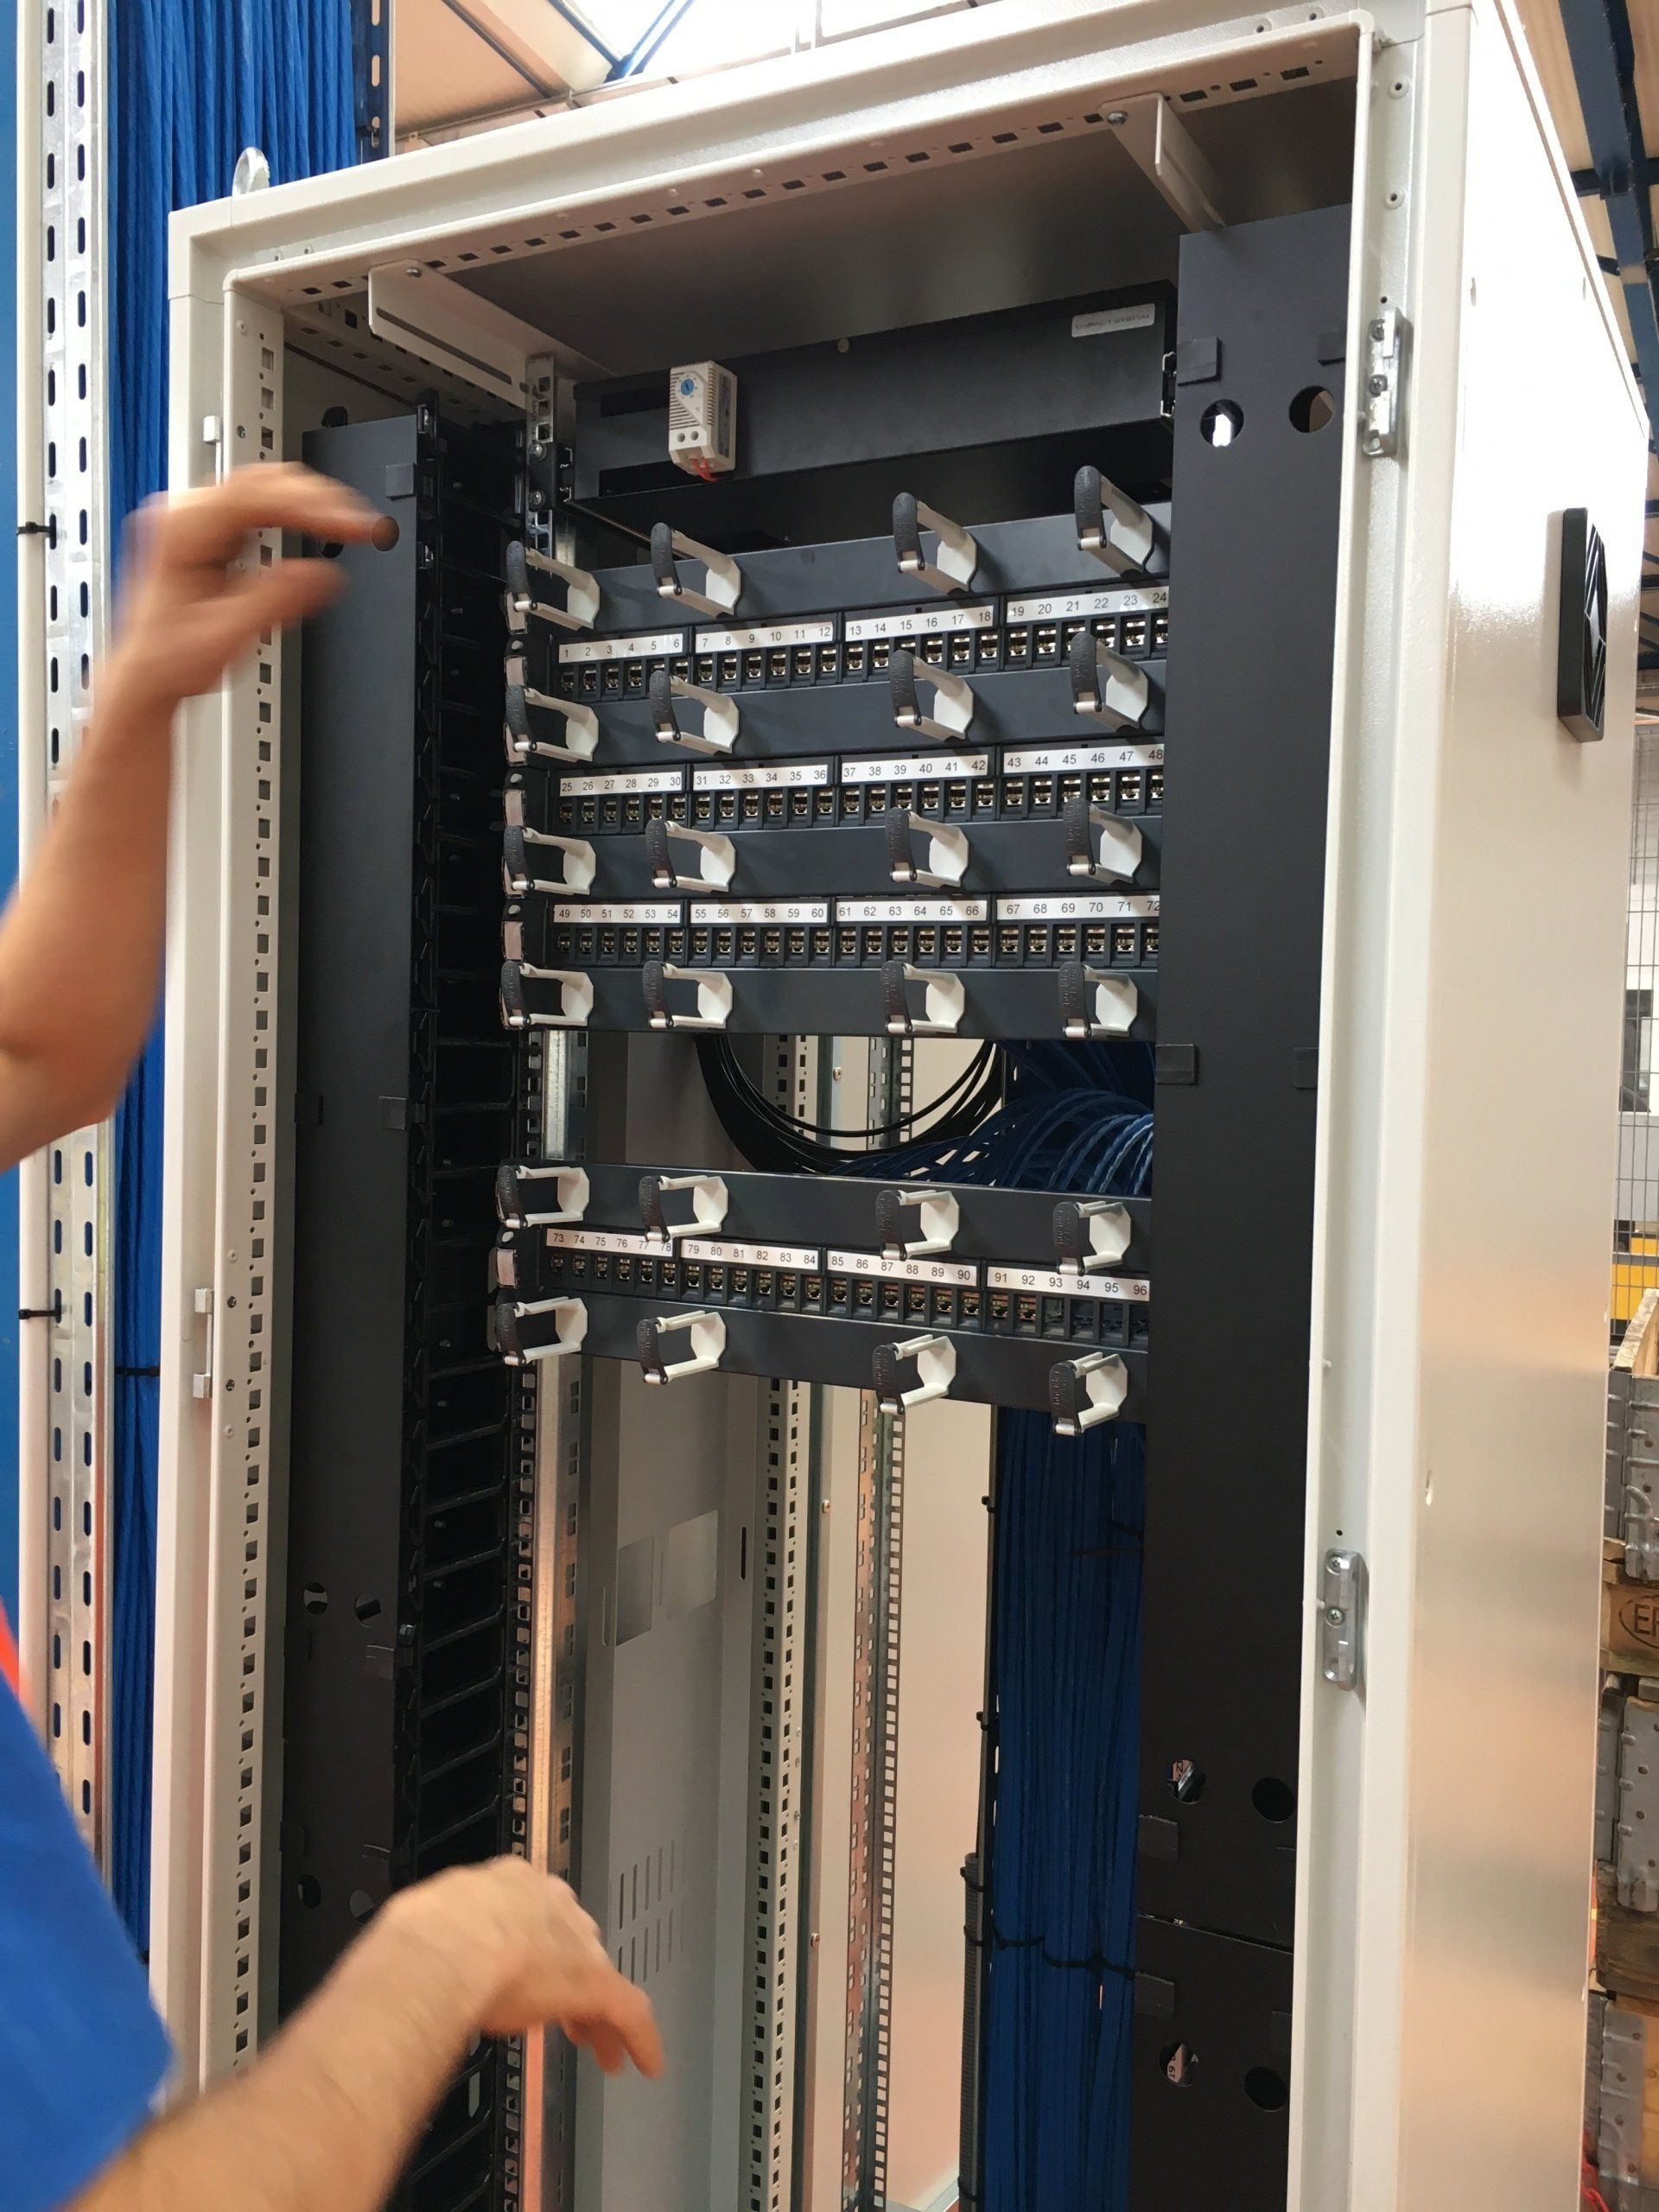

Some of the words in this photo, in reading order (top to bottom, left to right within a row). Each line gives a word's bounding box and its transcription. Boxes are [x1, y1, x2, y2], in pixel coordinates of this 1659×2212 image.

[1011, 606, 1025, 617] 19
[1037, 603, 1052, 615] 20
[1065, 601, 1079, 612] 21
[1094, 597, 1109, 609] 22
[1123, 594, 1138, 607] 23
[1152, 591, 1167, 604] 24
[849, 625, 861, 636] 13
[874, 622, 887, 633] 14
[899, 620, 912, 631] 15
[925, 617, 938, 628] 16
[951, 613, 964, 626] 17
[978, 611, 991, 622] 18
[702, 637, 709, 648] 7
[725, 635, 732, 645] 8
[748, 633, 755, 644] 9
[770, 631, 782, 642] 10
[794, 629, 805, 639] 11
[819, 626, 830, 637] 12
[564, 649, 569, 658] 1
[585, 646, 591, 657] 2
[606, 644, 613, 655] 3
[628, 643, 634, 652] 4
[651, 640, 657, 651] 5
[673, 638, 680, 648] 6
[1007, 757, 1021, 767] 43
[1034, 755, 1049, 766] 44
[1062, 753, 1077, 765] 45
[1090, 752, 1105, 764] 46
[1119, 750, 1135, 762] 47
[1147, 749, 1164, 760] 48
[696, 776, 707, 785] 31
[719, 774, 732, 785] 32
[742, 773, 754, 784] 33
[766, 772, 778, 783] 34
[790, 771, 802, 782] 35
[814, 769, 826, 780] 36
[844, 767, 856, 778] 37
[868, 766, 881, 777] 38
[893, 764, 907, 775] 39
[918, 763, 933, 773] 40
[944, 761, 957, 772] 41
[971, 760, 986, 771] 42
[562, 782, 573, 792] 25
[582, 780, 594, 791] 26
[603, 779, 615, 790] 27
[625, 778, 637, 789] 28
[647, 777, 659, 788] 29
[670, 776, 682, 786] 30
[558, 908, 570, 918] 49
[580, 908, 592, 918] 50
[601, 908, 612, 918] 51
[623, 908, 634, 918] 52
[645, 909, 657, 919] 53
[667, 909, 678, 918] 54
[695, 908, 707, 918] 55
[717, 908, 730, 918] 56
[740, 908, 753, 918] 57
[764, 907, 776, 918] 58
[787, 908, 800, 918] 59
[811, 907, 824, 918] 60
[837, 906, 851, 917] 61
[863, 906, 877, 917] 62
[888, 906, 902, 917] 63
[913, 906, 927, 916] 64
[939, 906, 953, 916] 65
[965, 905, 979, 916] 66
[1006, 904, 1020, 915] 67
[1033, 903, 1047, 914] 68
[1061, 902, 1076, 913] 69
[1089, 901, 1103, 913] 70
[1117, 900, 1131, 912] 71
[1146, 899, 1160, 912] 72
[553, 1232, 564, 1243] 73
[573, 1234, 585, 1244] 74
[595, 1236, 607, 1247] 75
[616, 1237, 628, 1249] 76
[638, 1240, 650, 1250] 77
[659, 1241, 672, 1252] 78
[688, 1243, 700, 1255] 79
[710, 1246, 722, 1256] 80
[733, 1248, 744, 1258] 81
[756, 1249, 769, 1261] 82
[779, 1252, 792, 1263] 83
[804, 1254, 816, 1265] 84
[831, 1255, 844, 1267] 85
[855, 1258, 868, 1269] 86
[880, 1261, 894, 1272] 87
[906, 1263, 919, 1275] 88
[931, 1267, 944, 1278] 89
[957, 1269, 970, 1281] 90
[995, 1272, 1007, 1283] 91
[1021, 1274, 1035, 1286] 92
[1049, 1276, 1063, 1288] 93
[1077, 1279, 1090, 1291] 94
[1104, 1281, 1119, 1294] 95
[1133, 1284, 1147, 1296] 96
